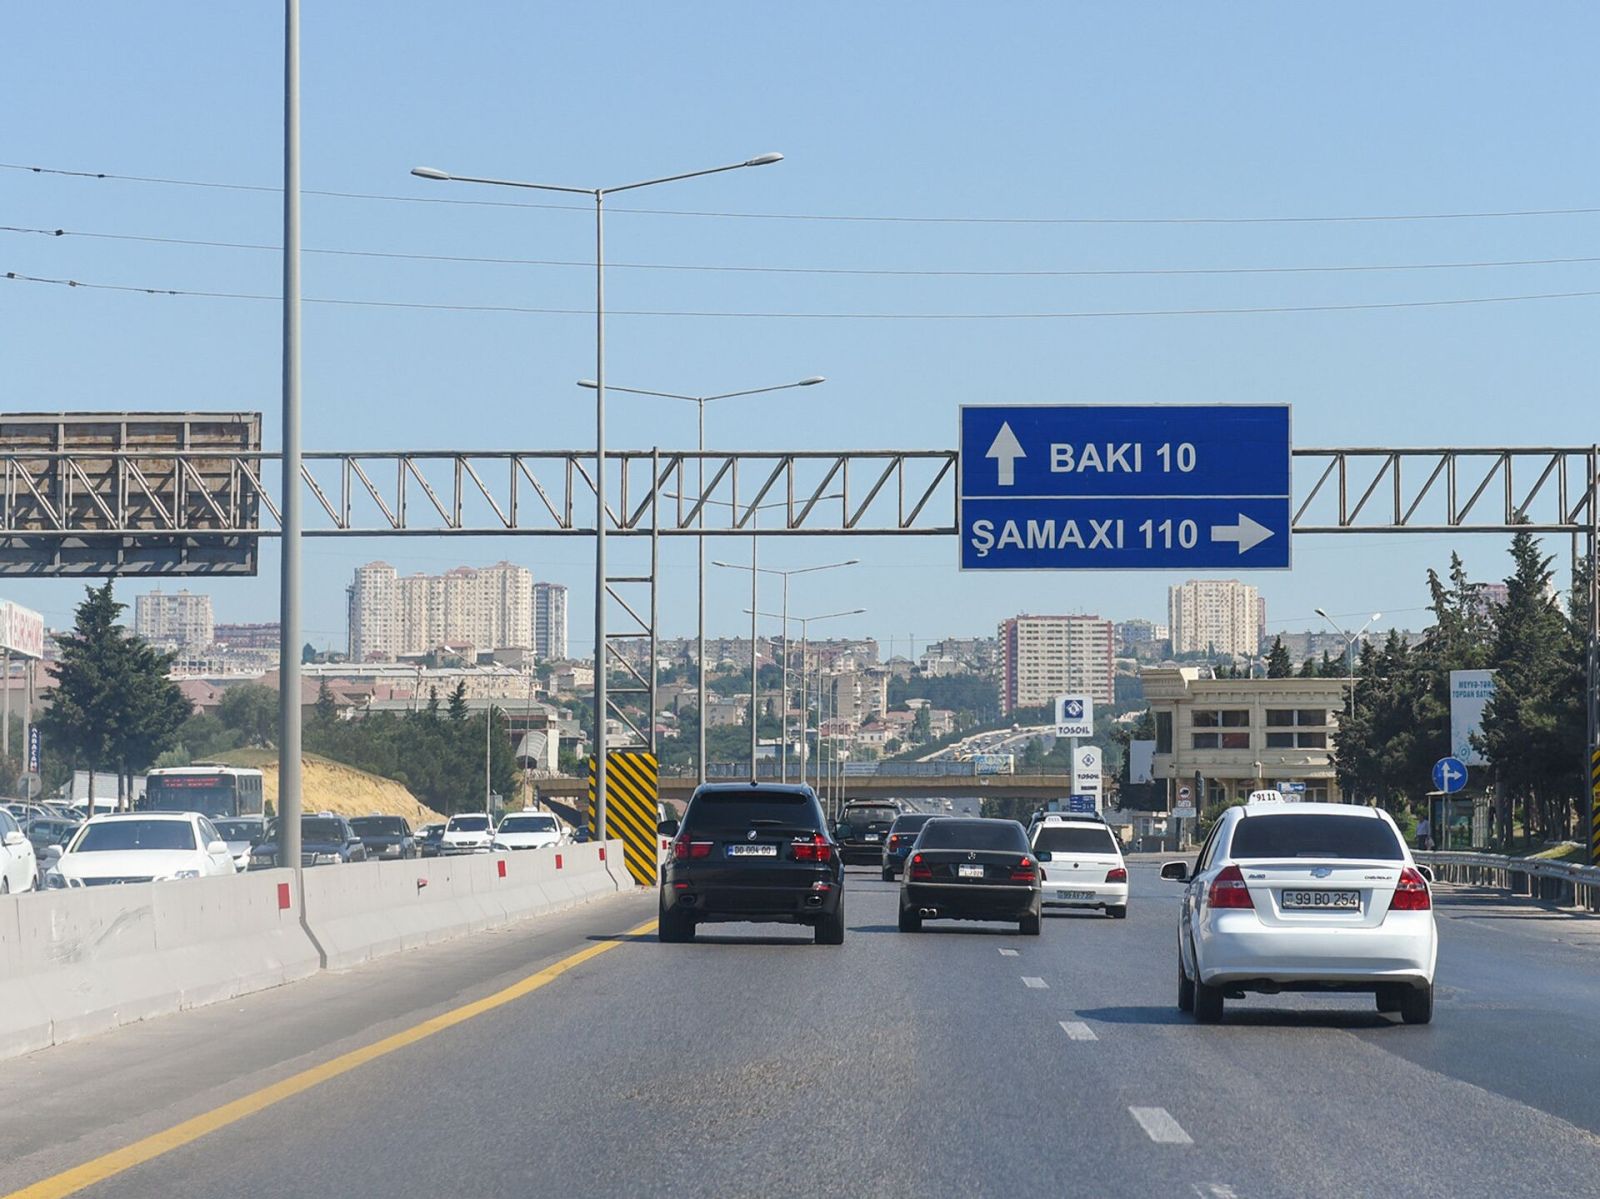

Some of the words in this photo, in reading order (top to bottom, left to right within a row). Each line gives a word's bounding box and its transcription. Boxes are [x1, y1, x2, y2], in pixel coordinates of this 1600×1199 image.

[1050, 443, 1142, 473] BAKI
[1156, 443, 1196, 473] 10
[971, 519, 1124, 557] ŞAMAXI
[1139, 519, 1198, 549] 110
[1058, 726, 1090, 735] TOSOIL
[1295, 893, 1311, 905] 99
[1333, 893, 1356, 905] 254
